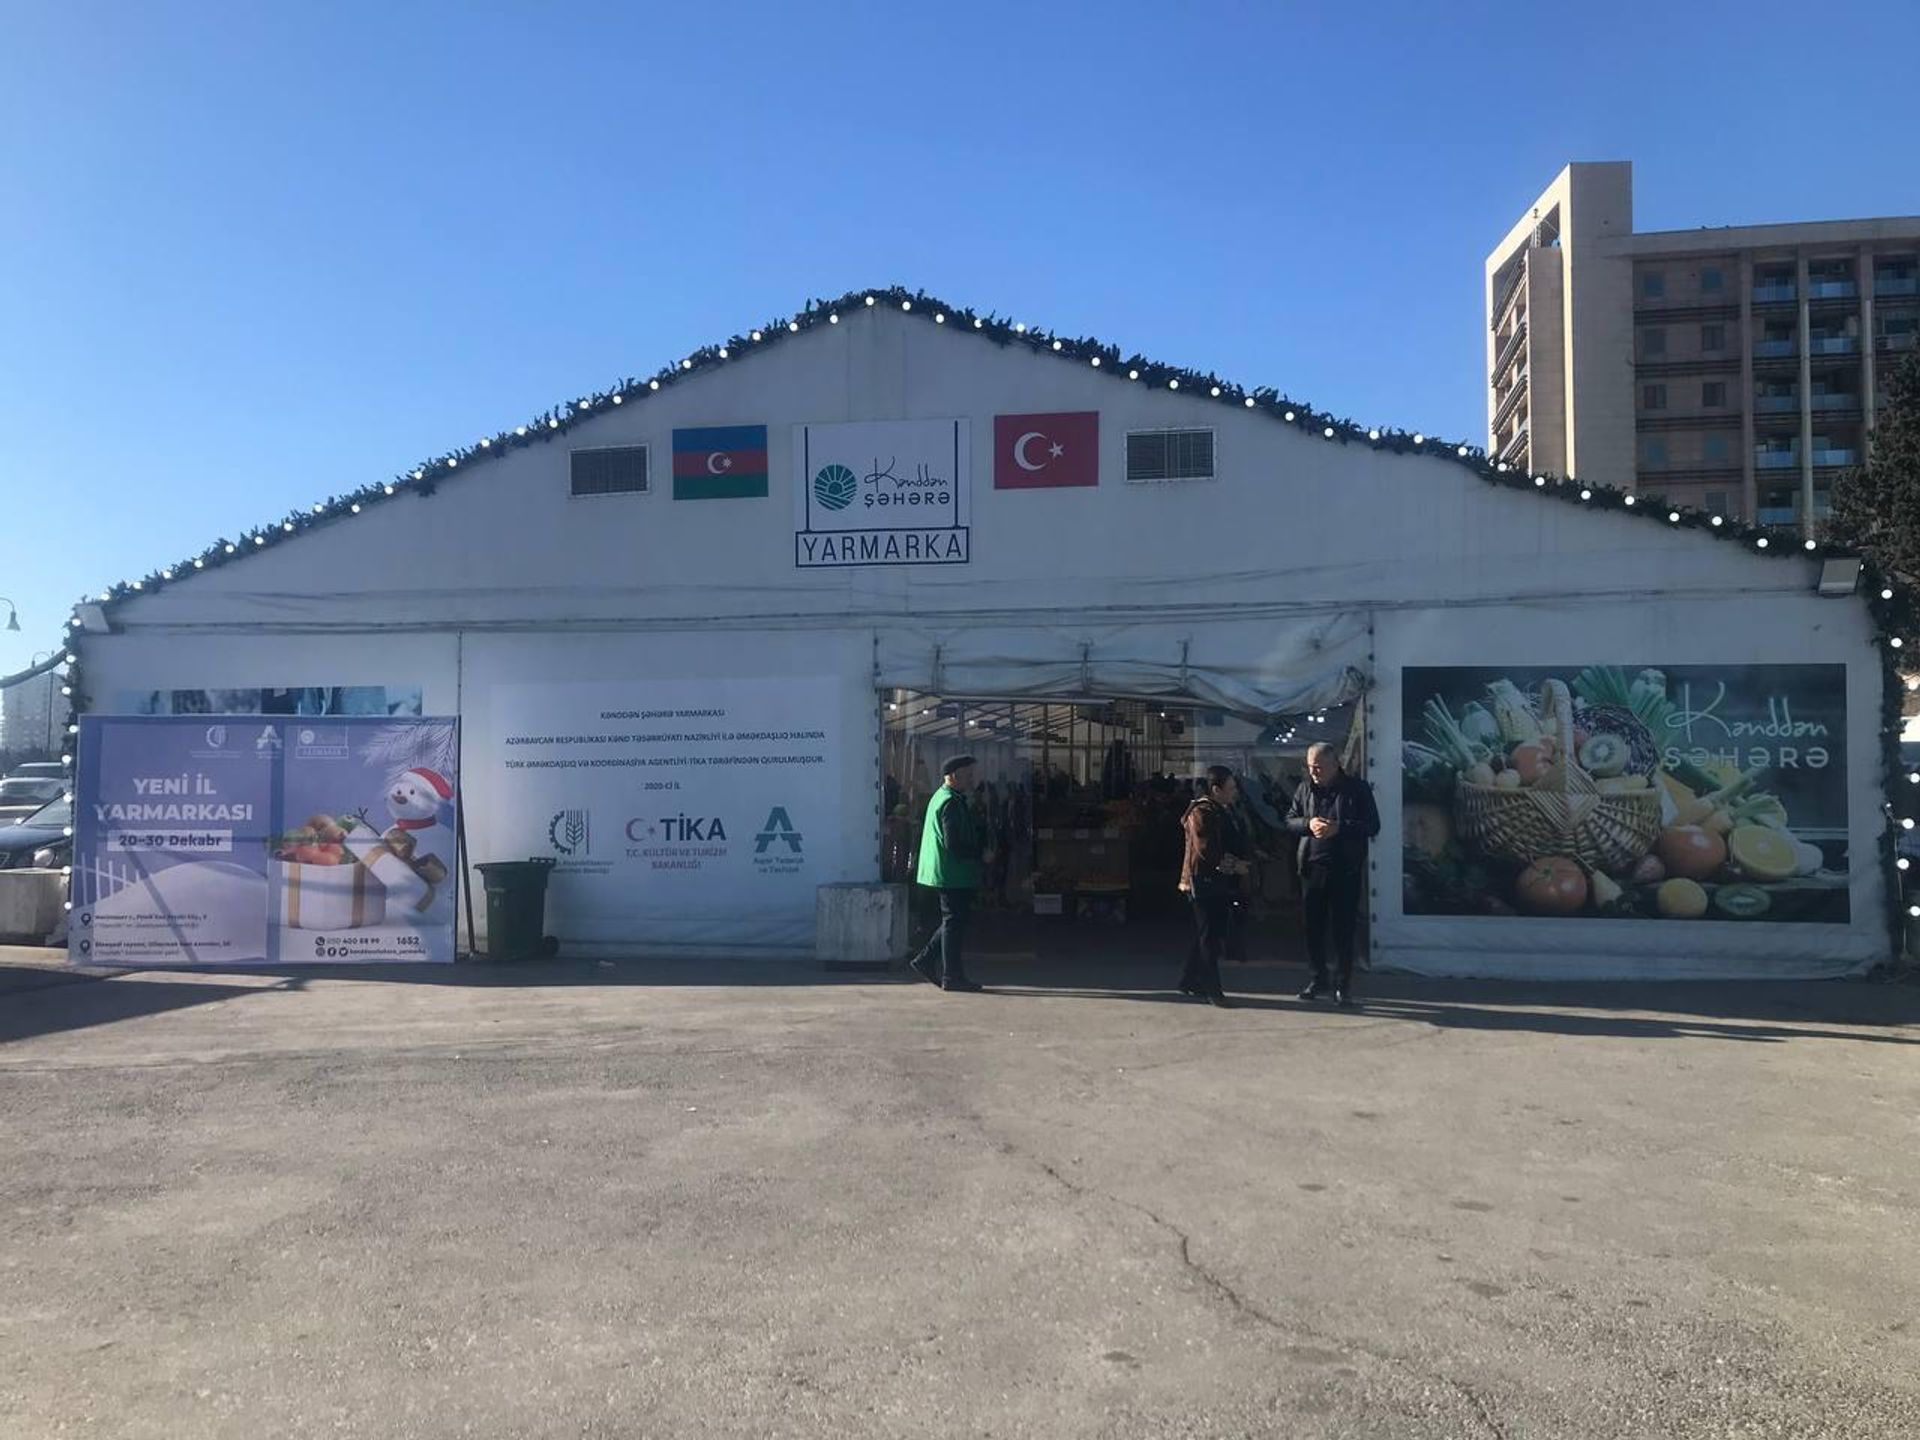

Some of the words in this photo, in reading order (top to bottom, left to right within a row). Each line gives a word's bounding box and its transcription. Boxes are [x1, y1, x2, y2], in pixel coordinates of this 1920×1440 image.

[803, 532, 962, 562] YARMARKA
[132, 773, 189, 796] YENİ
[195, 772, 217, 796] İL
[93, 803, 253, 823] YARMARKASI
[659, 812, 727, 841] TİKA
[118, 833, 164, 848] 20-30
[168, 832, 222, 848] Dekabr
[395, 935, 420, 945] 1652
